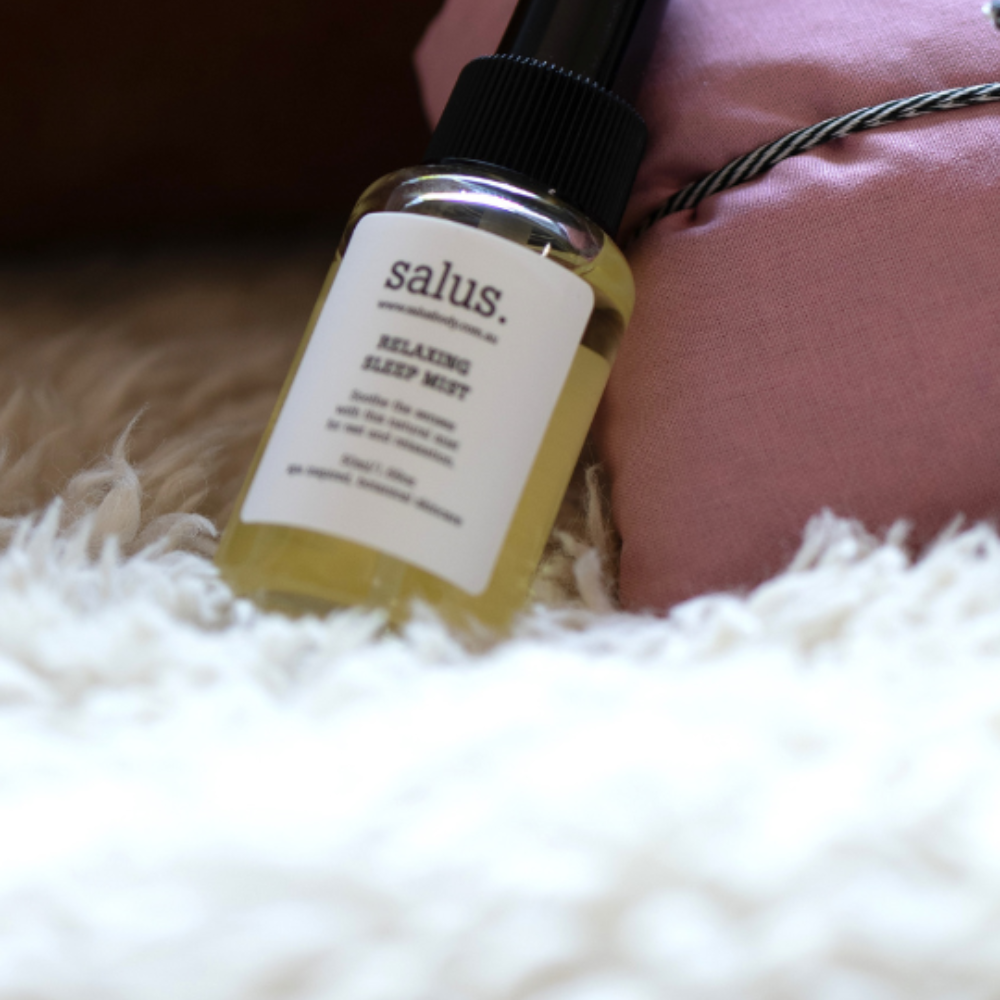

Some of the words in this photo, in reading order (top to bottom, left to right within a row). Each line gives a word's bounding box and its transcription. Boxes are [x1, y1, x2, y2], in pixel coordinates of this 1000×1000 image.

[384, 260, 507, 325] salus.
[362, 355, 418, 381] SLEEP
[421, 370, 471, 401] MIST
[377, 334, 471, 376] RELAXING
